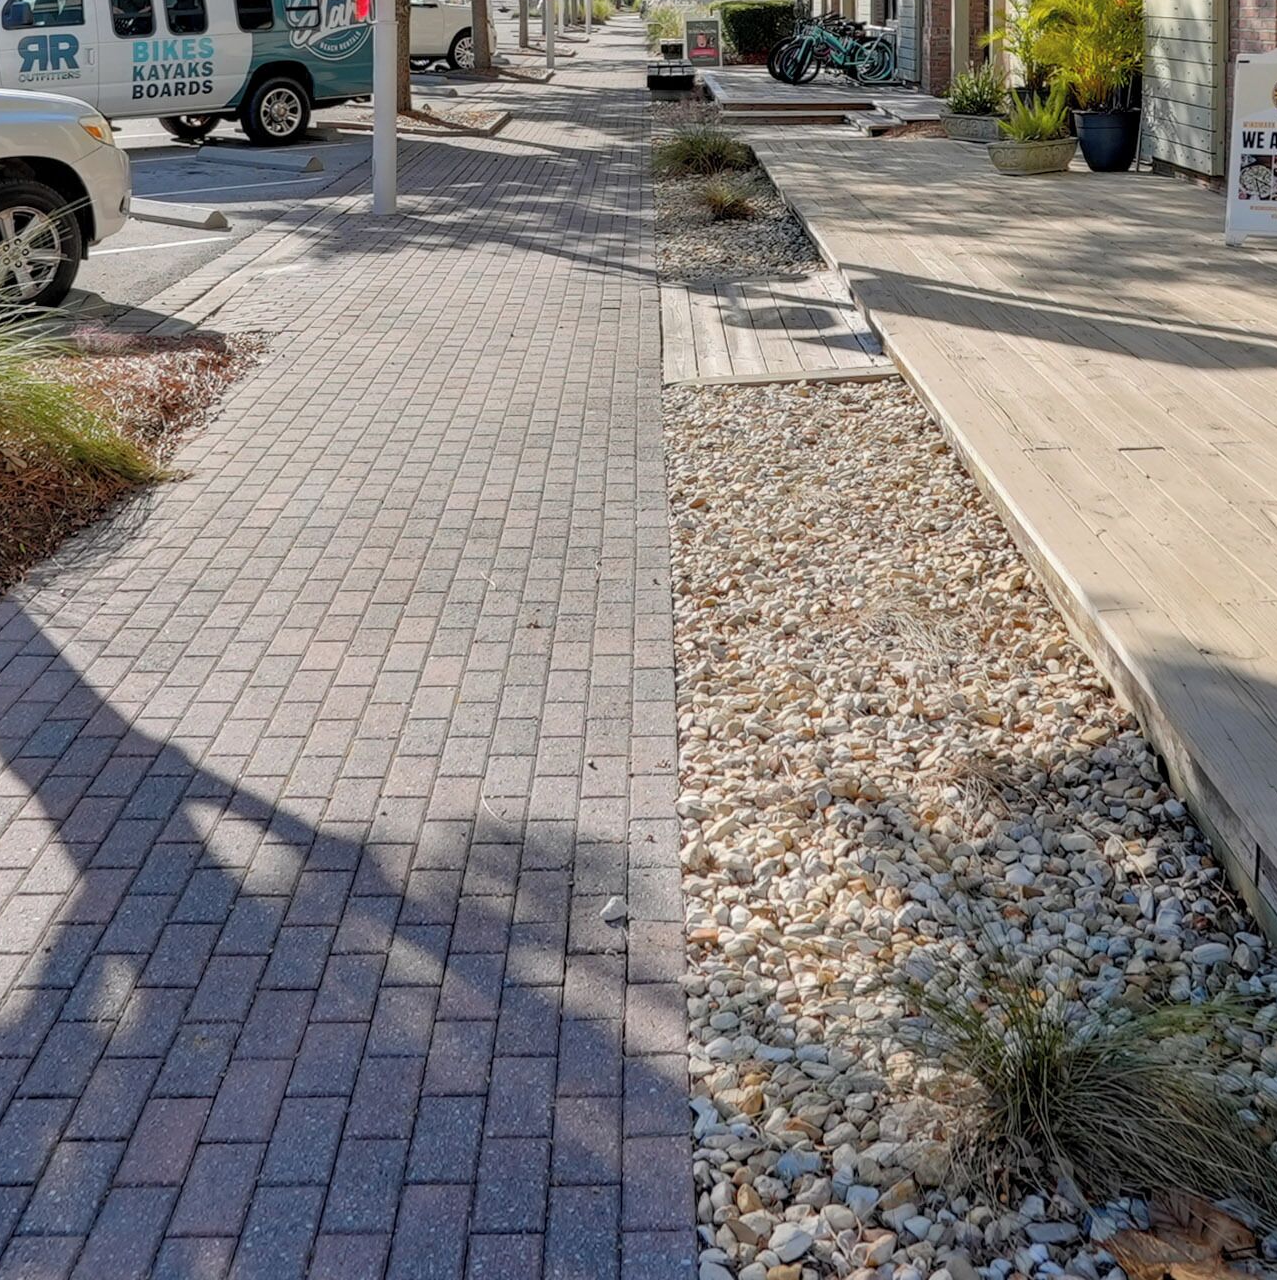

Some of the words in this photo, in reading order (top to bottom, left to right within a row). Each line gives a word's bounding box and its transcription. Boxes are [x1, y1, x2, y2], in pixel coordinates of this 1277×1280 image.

[132, 37, 215, 63] BIKES
[18, 70, 82, 84] OUTFITTERS
[132, 61, 214, 82] KAYAKS
[132, 79, 214, 100] BOARDS
[1242, 131, 1265, 149] WE
